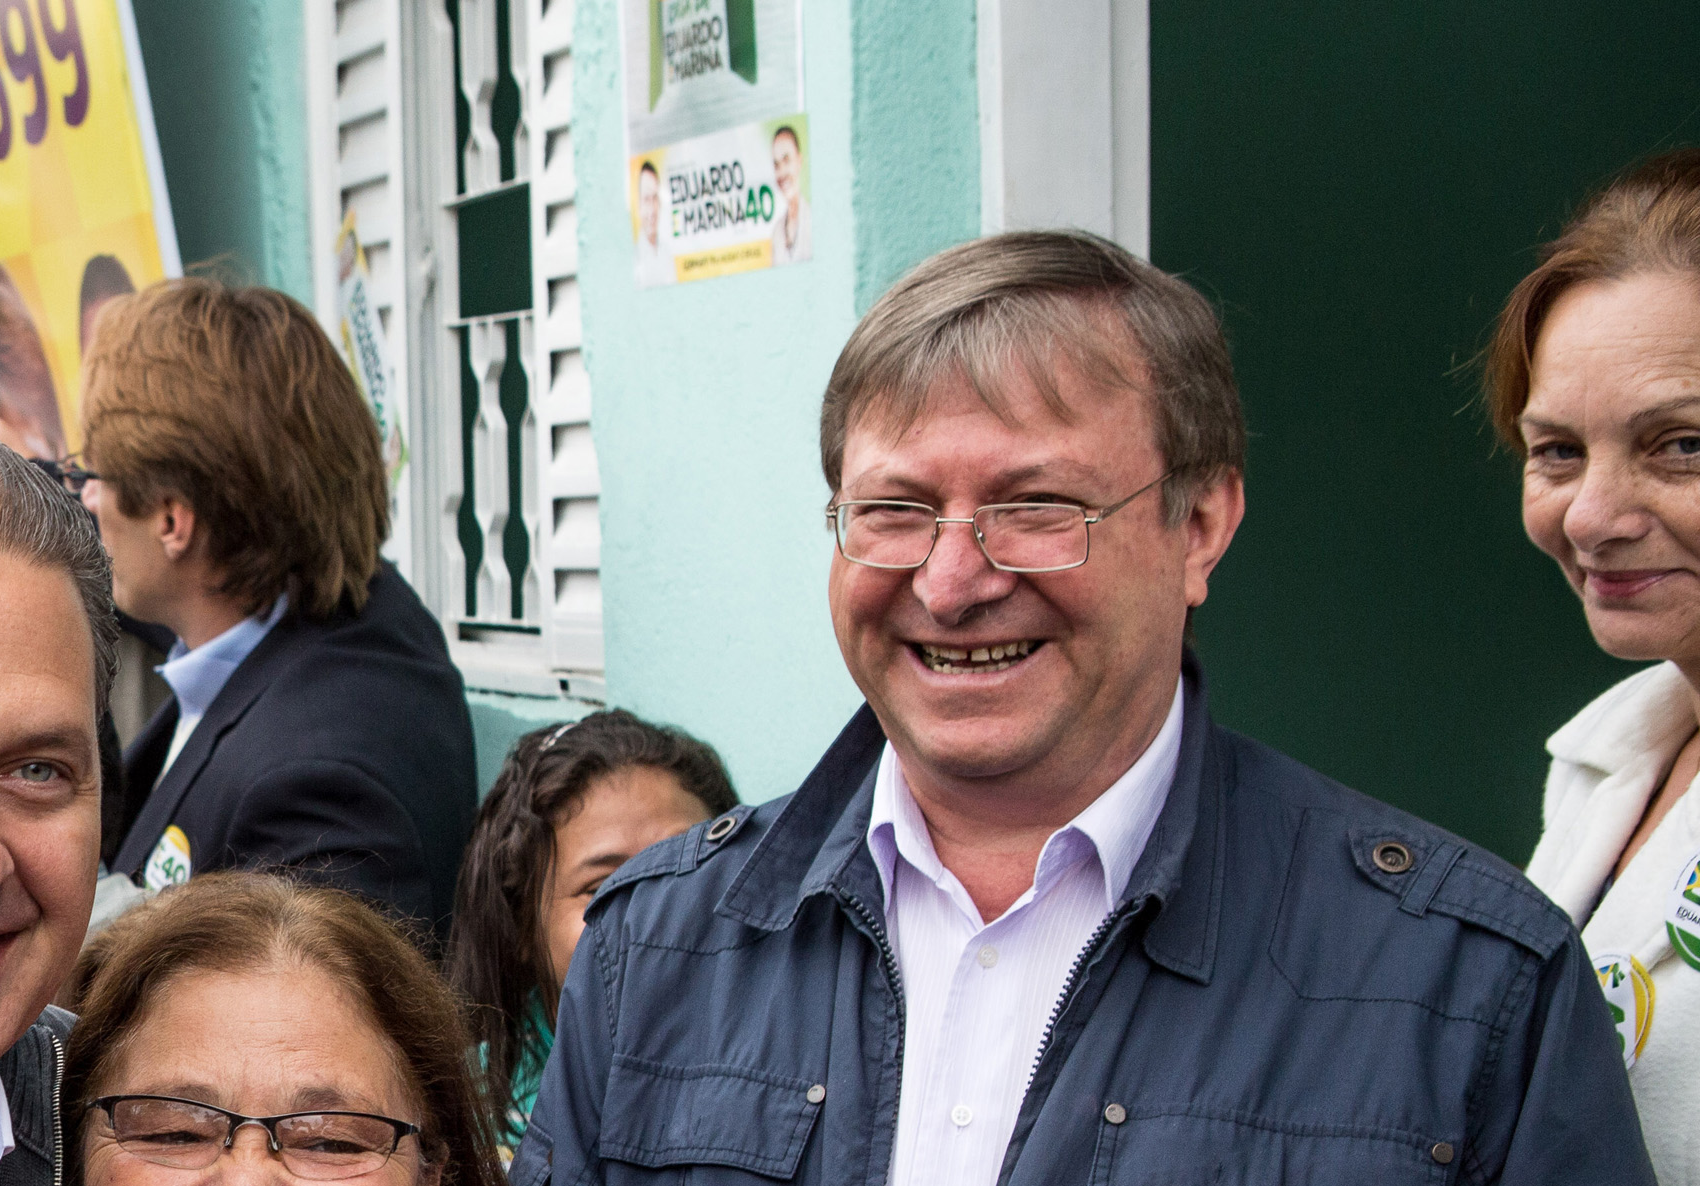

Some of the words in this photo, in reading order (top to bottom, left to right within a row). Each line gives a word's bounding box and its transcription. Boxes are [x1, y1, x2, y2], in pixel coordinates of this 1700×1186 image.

[669, 160, 745, 204] EDUARDO
[683, 197, 746, 236] MARINA
[746, 184, 774, 224] 40
